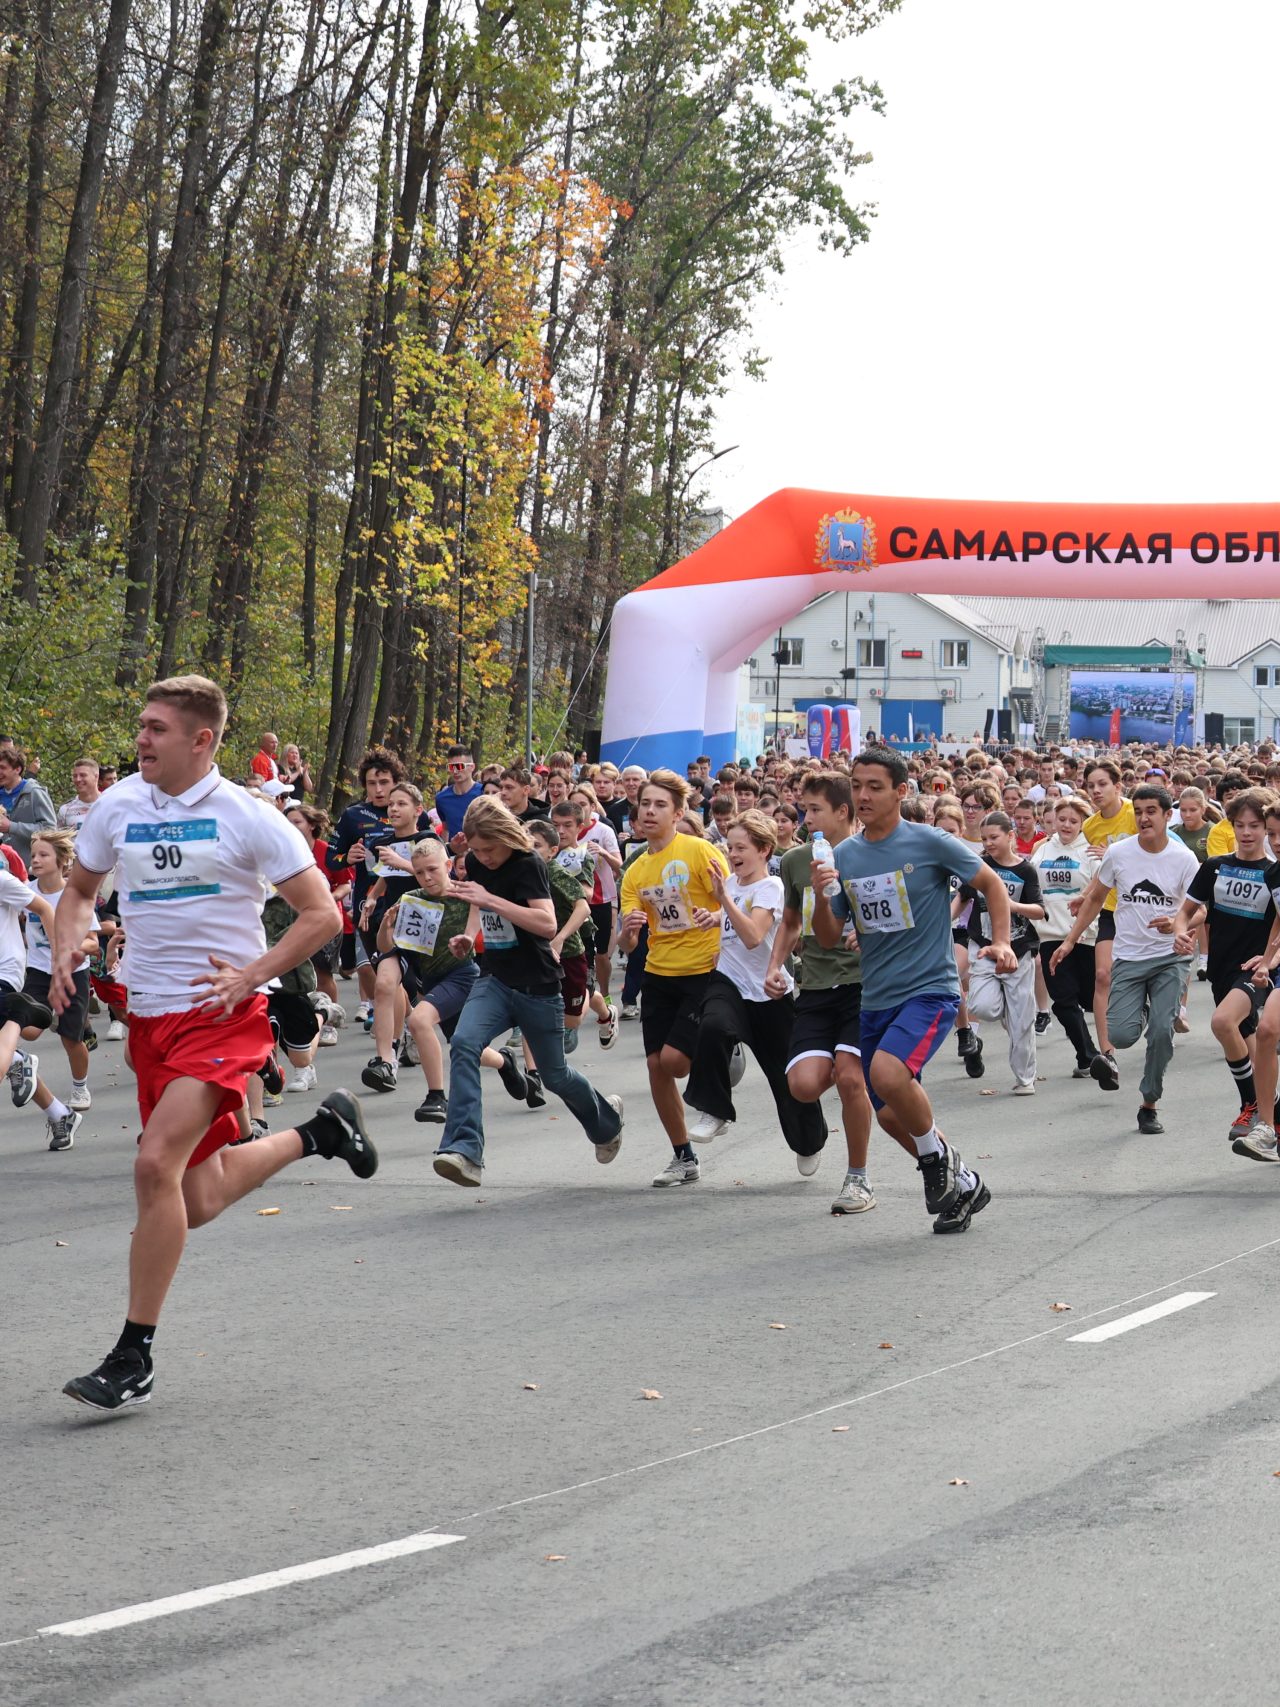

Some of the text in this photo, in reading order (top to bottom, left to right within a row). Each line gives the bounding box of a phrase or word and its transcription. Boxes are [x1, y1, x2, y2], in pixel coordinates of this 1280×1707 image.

[889, 526, 1172, 563] САМАРСКАЯ
[152, 844, 183, 870] 90
[1045, 870, 1072, 883] 1989
[1122, 893, 1173, 907] SIMMS
[1225, 879, 1262, 900] 1097
[657, 904, 680, 921] 46
[861, 899, 892, 921] 878
[404, 909, 423, 937] 413
